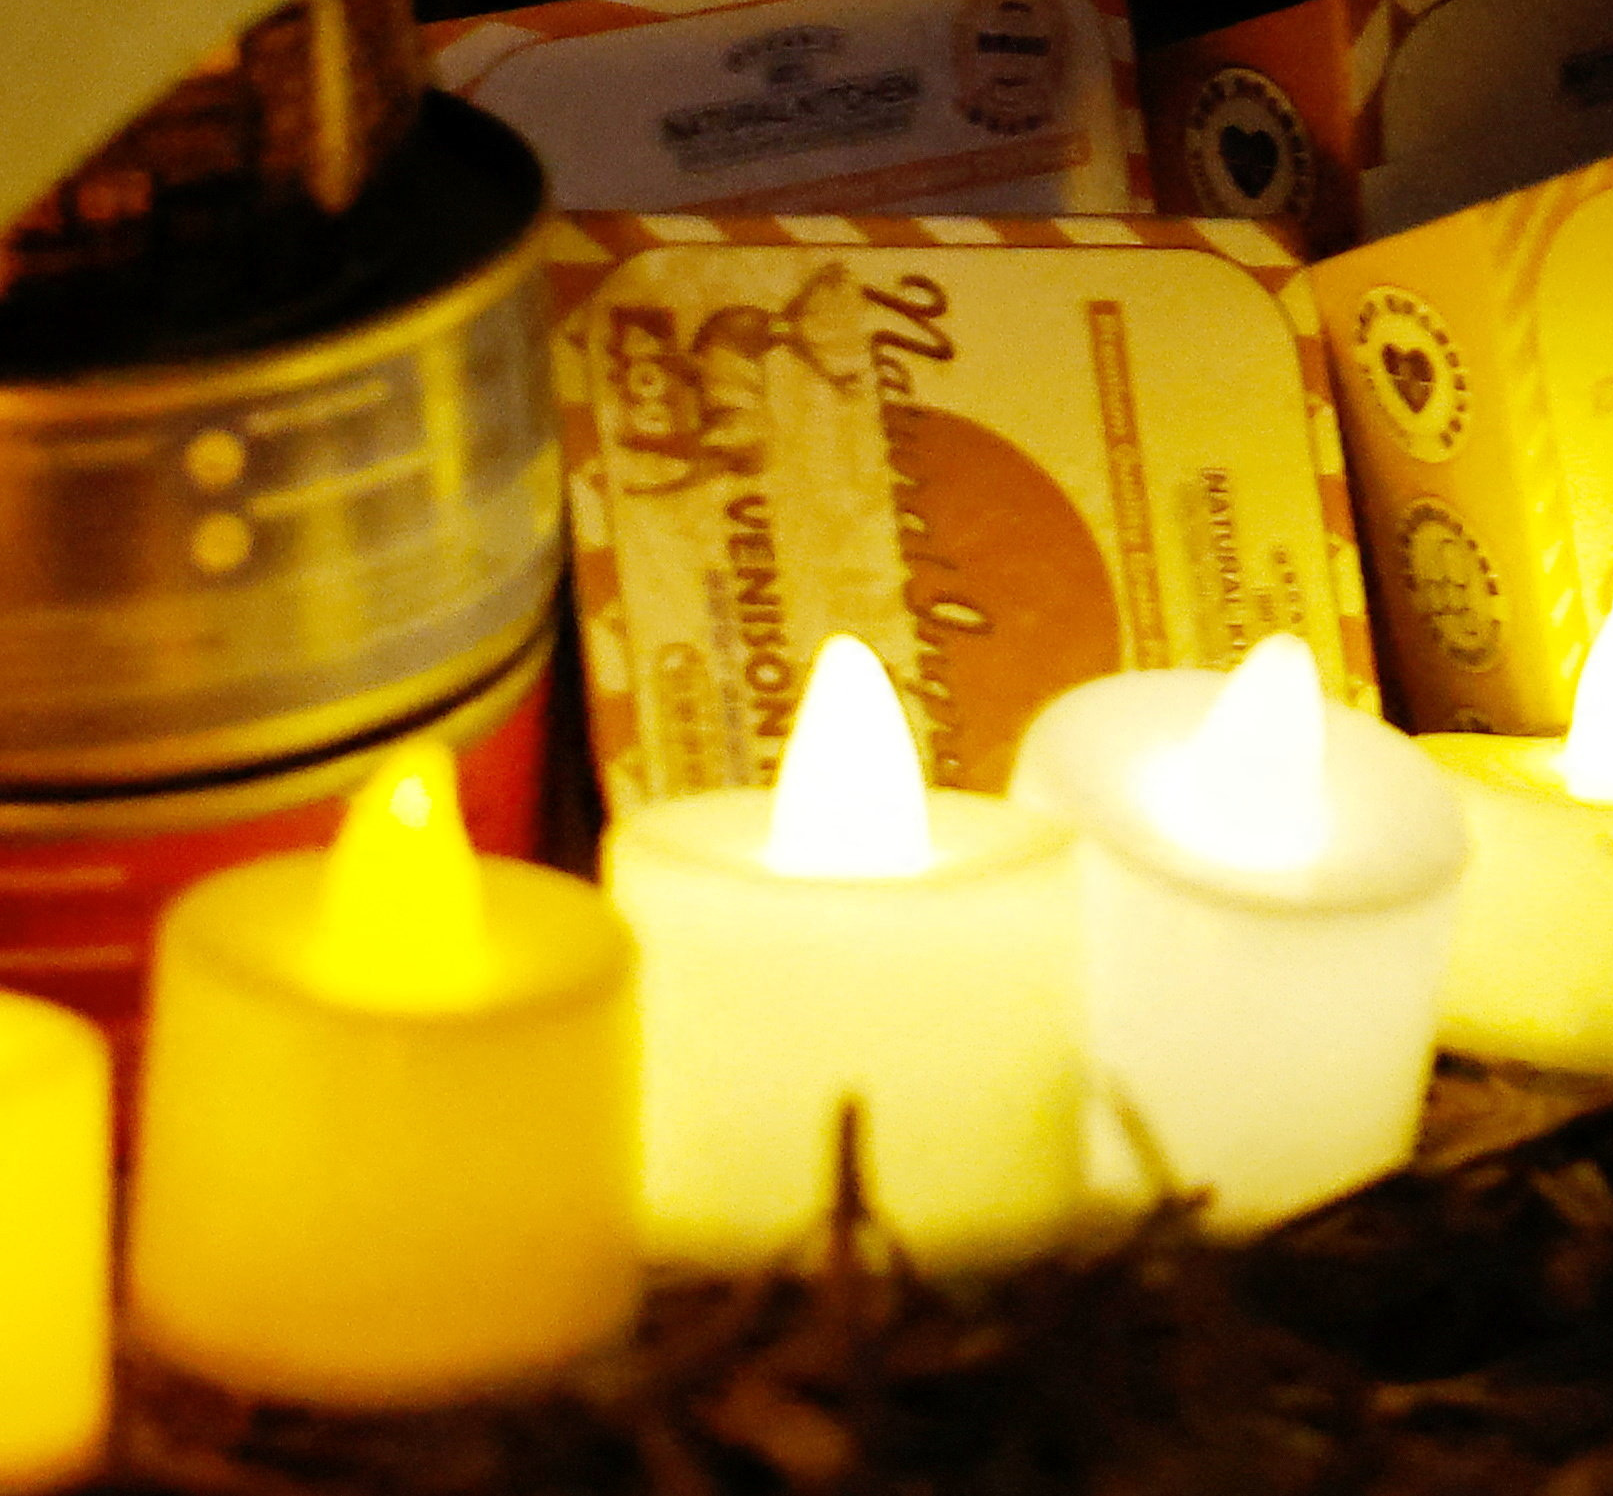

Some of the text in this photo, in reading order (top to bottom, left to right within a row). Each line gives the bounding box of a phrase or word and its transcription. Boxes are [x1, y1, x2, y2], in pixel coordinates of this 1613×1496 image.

[860, 274, 956, 569] Natural
[1205, 470, 1244, 610] NATURAL
[727, 496, 797, 739] VENISON
